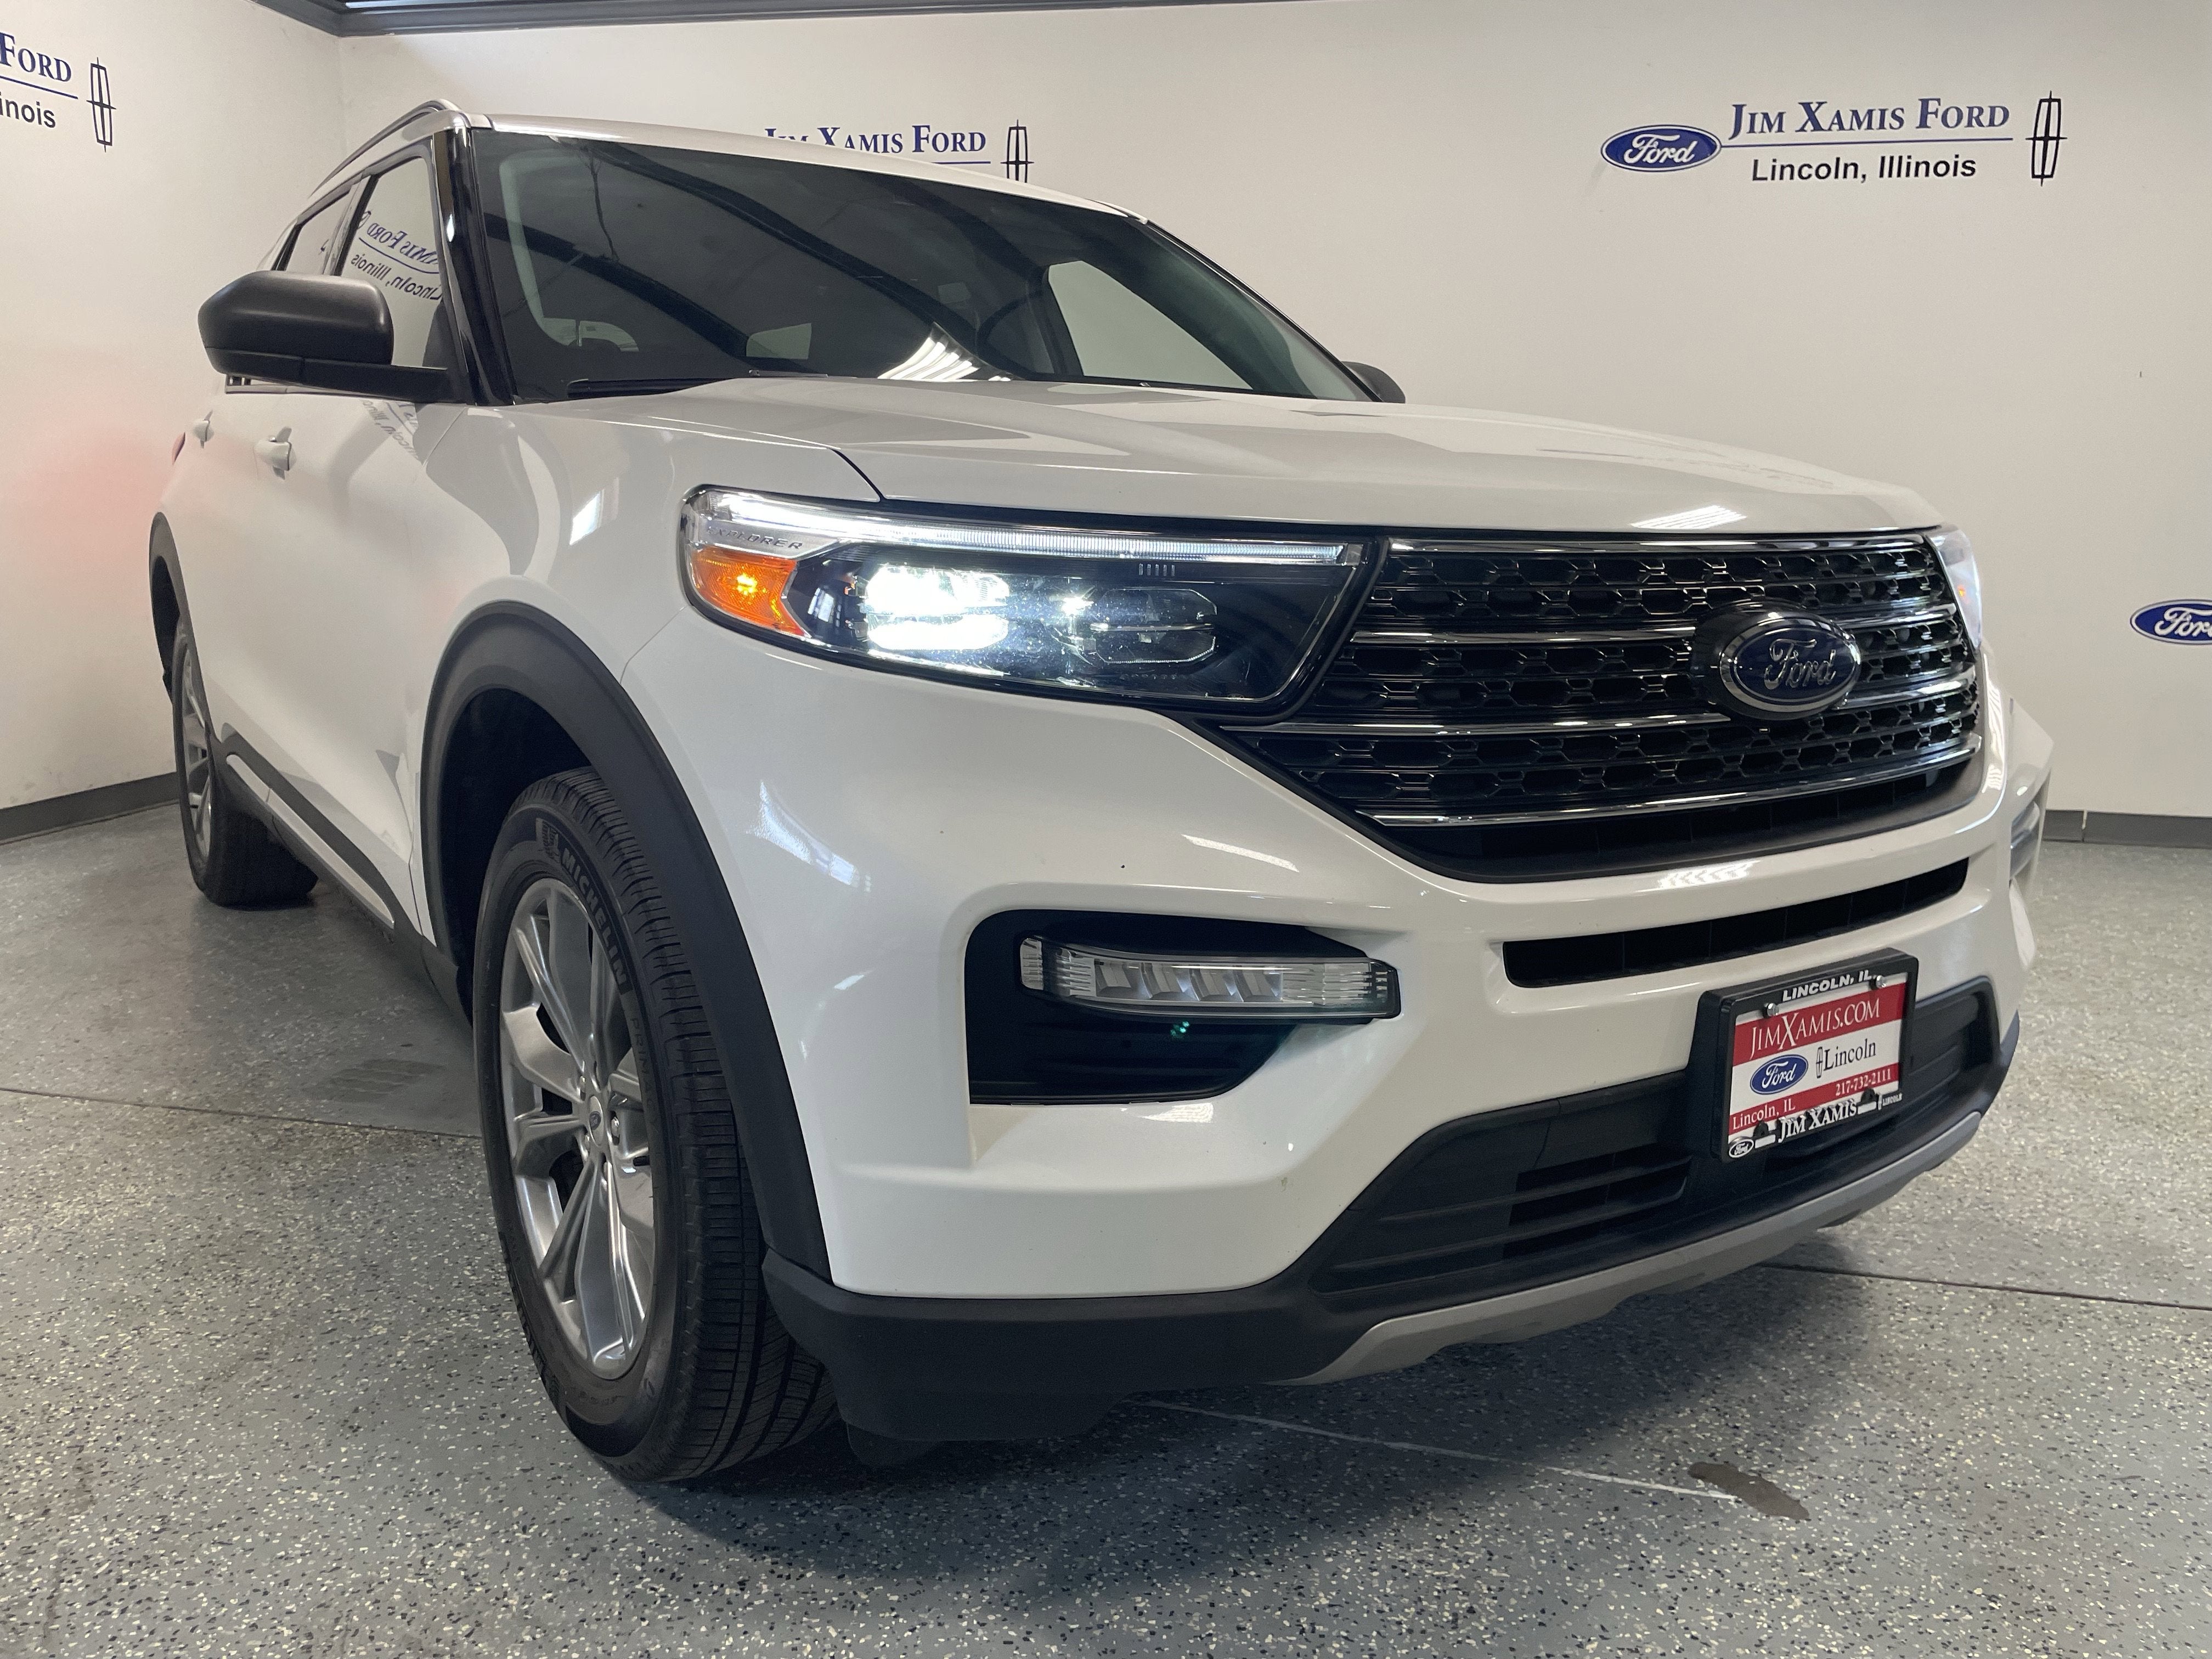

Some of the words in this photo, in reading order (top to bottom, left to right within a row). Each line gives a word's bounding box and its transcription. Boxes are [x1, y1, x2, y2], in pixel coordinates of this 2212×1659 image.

[0, 32, 71, 82] FORD
[1728, 104, 1786, 140] JIM
[1795, 101, 1905, 132] XAMIS
[1916, 98, 2010, 129] FORD
[912, 125, 986, 153] FORD
[1624, 133, 1698, 163] Ford
[1753, 156, 1866, 183] Lincoln,
[1879, 154, 1976, 178] Illinois
[2154, 607, 2212, 637] For
[1764, 639, 1836, 690] Ford
[561, 847, 628, 988] MICHELIN
[1783, 974, 1854, 1002] LINCOLN,
[1750, 997, 1880, 1059] JIMXAMIS.COM
[1823, 1038, 1876, 1071] Lincoln
[1762, 1062, 1796, 1089] Ford
[1733, 1104, 1779, 1130] Lincoln,
[1784, 1098, 1796, 1113] IL
[1778, 1116, 1807, 1143] JIM
[1809, 1099, 1857, 1130] XAMIS
